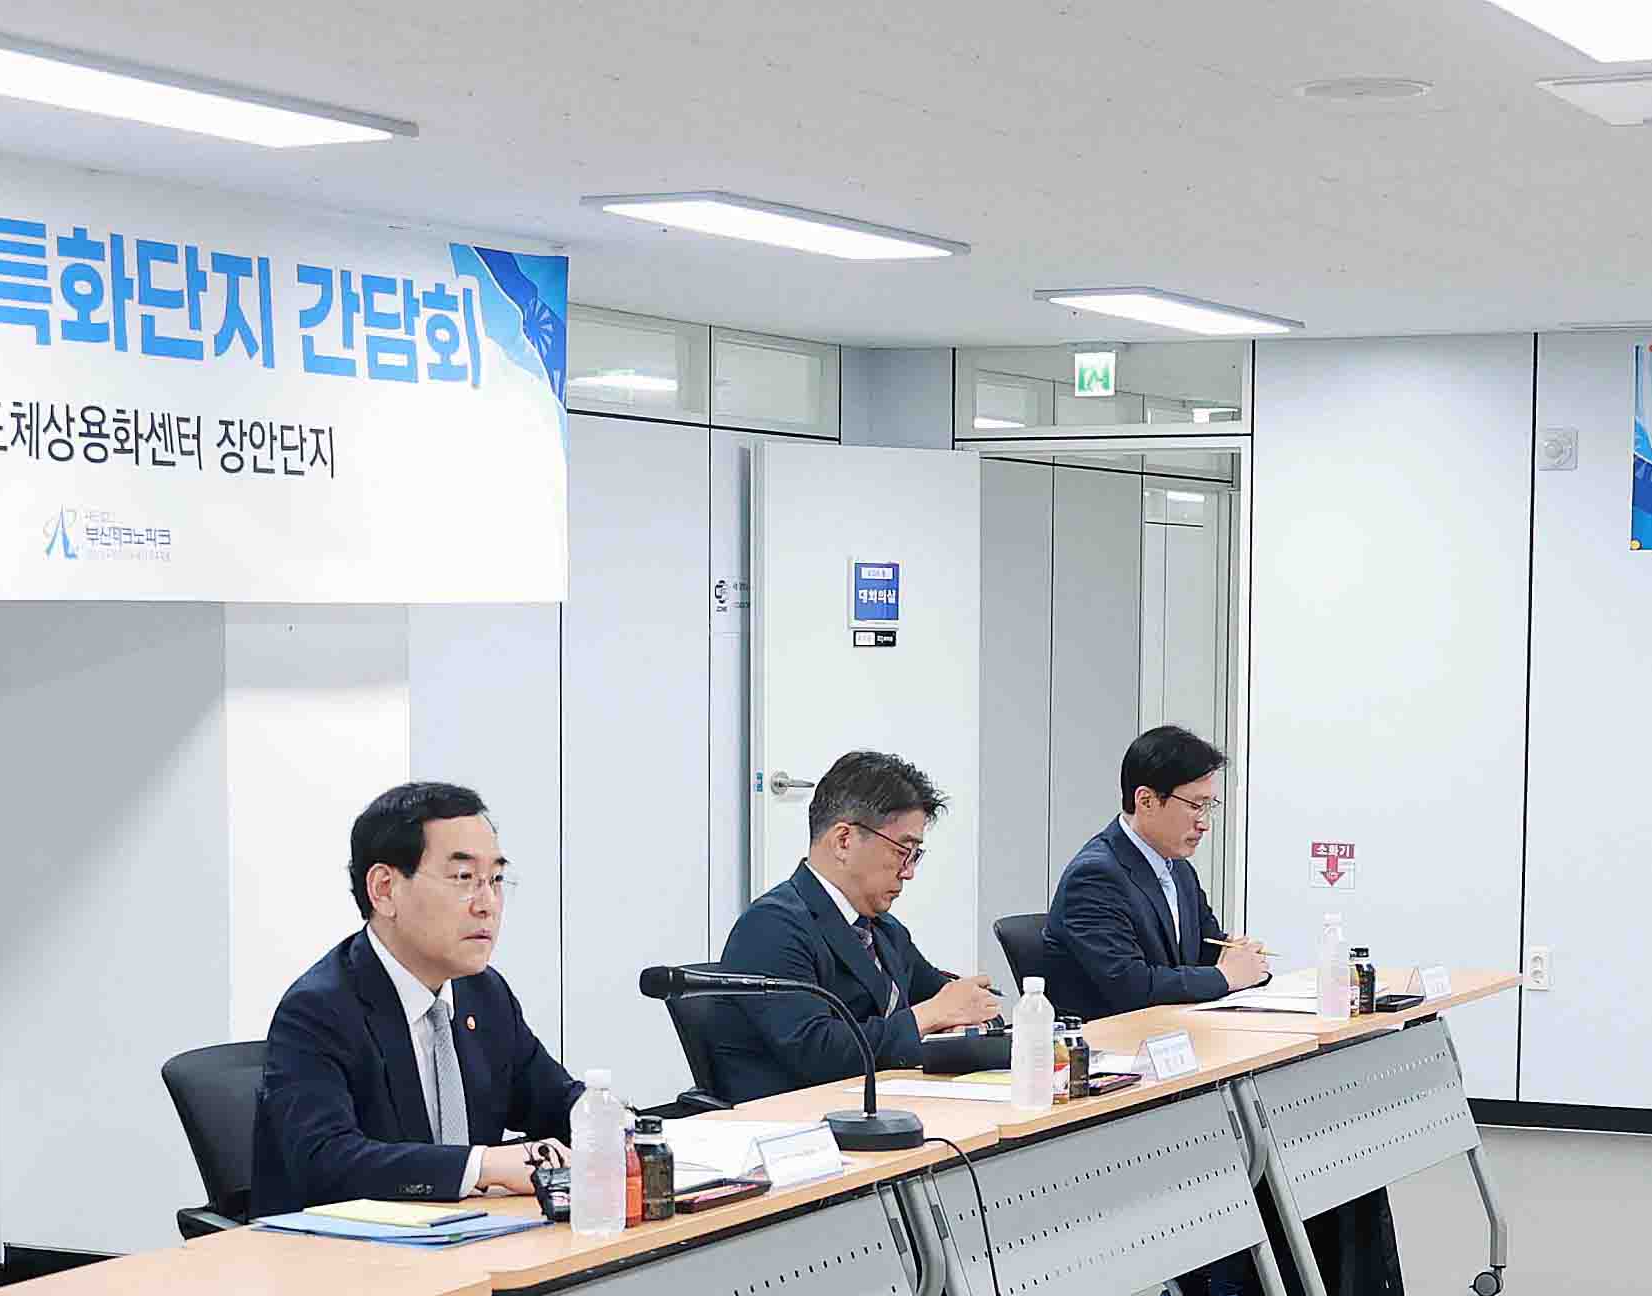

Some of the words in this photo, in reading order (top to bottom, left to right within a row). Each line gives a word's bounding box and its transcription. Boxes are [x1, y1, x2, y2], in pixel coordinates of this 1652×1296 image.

[296, 262, 482, 386] 간담회
[215, 418, 336, 480] 장안단지
[858, 588, 897, 604] 대회의실
